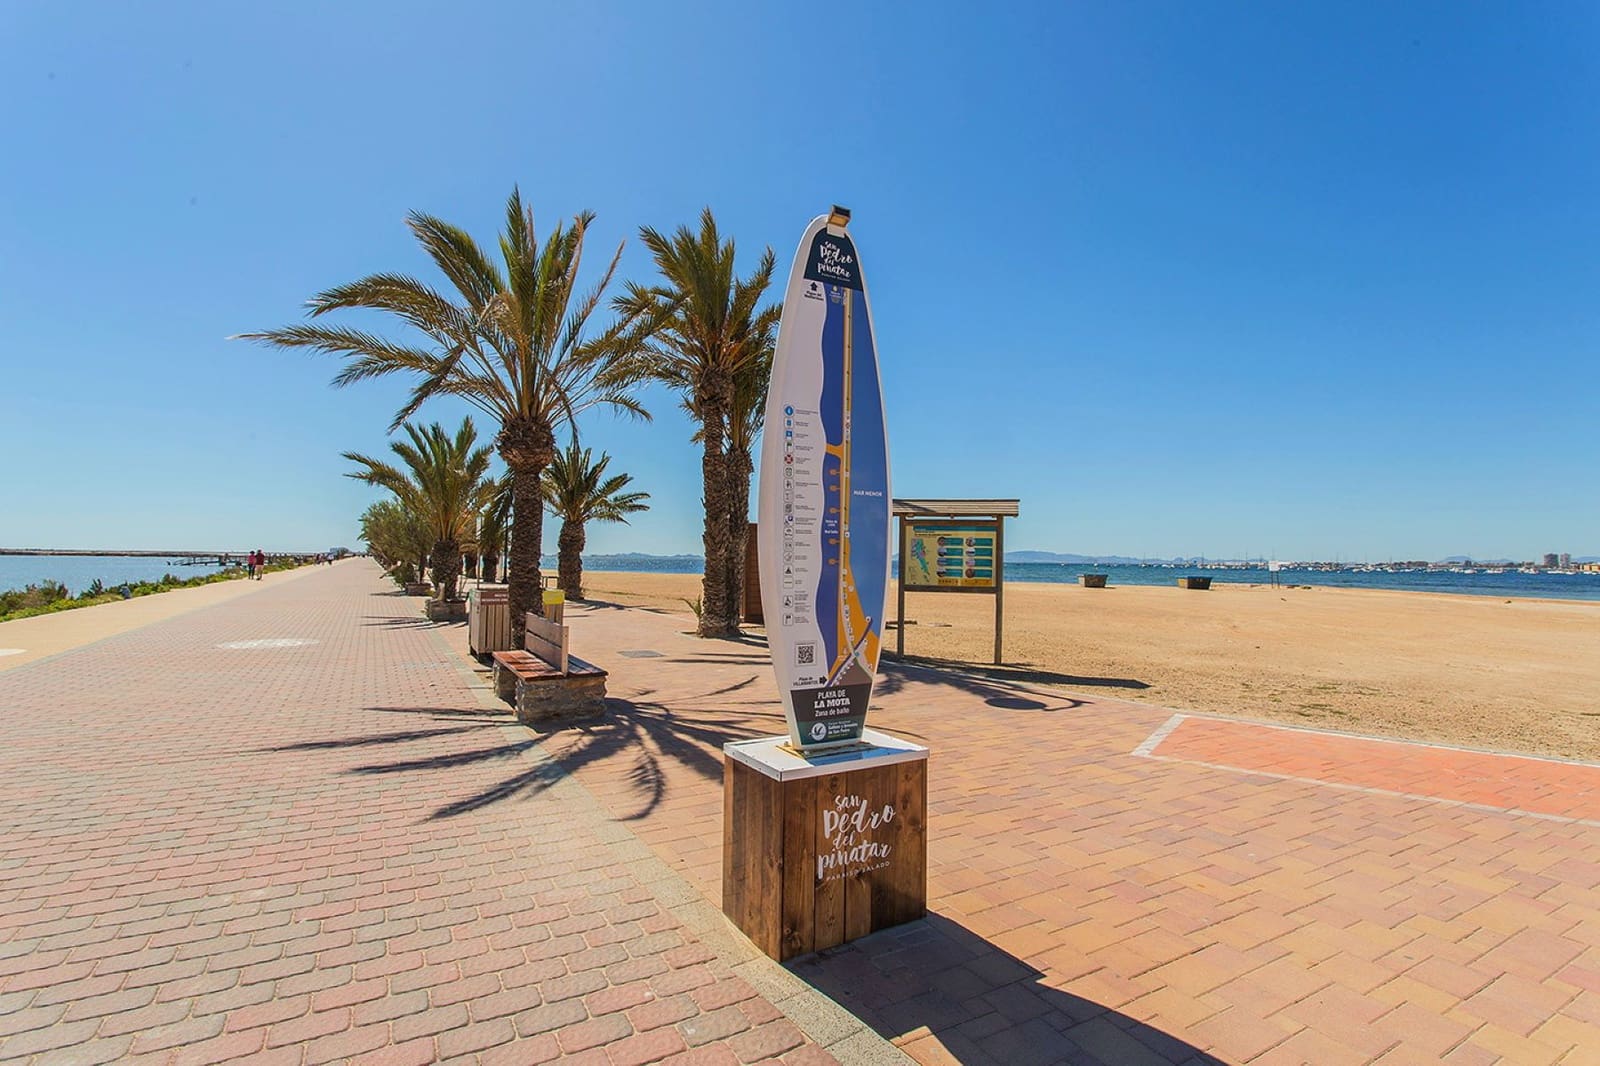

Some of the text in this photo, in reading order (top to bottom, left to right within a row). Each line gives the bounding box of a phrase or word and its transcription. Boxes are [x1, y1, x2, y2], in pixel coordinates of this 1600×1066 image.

[820, 244, 853, 264] Pedro
[814, 697, 851, 709] LA MOTA
[817, 689, 846, 699] PLAYA DE
[815, 709, 829, 717] Zona
[829, 708, 836, 716] de
[834, 794, 860, 812] san
[823, 799, 896, 839] Pedro
[832, 830, 856, 850] del
[818, 839, 892, 880] pinatar
